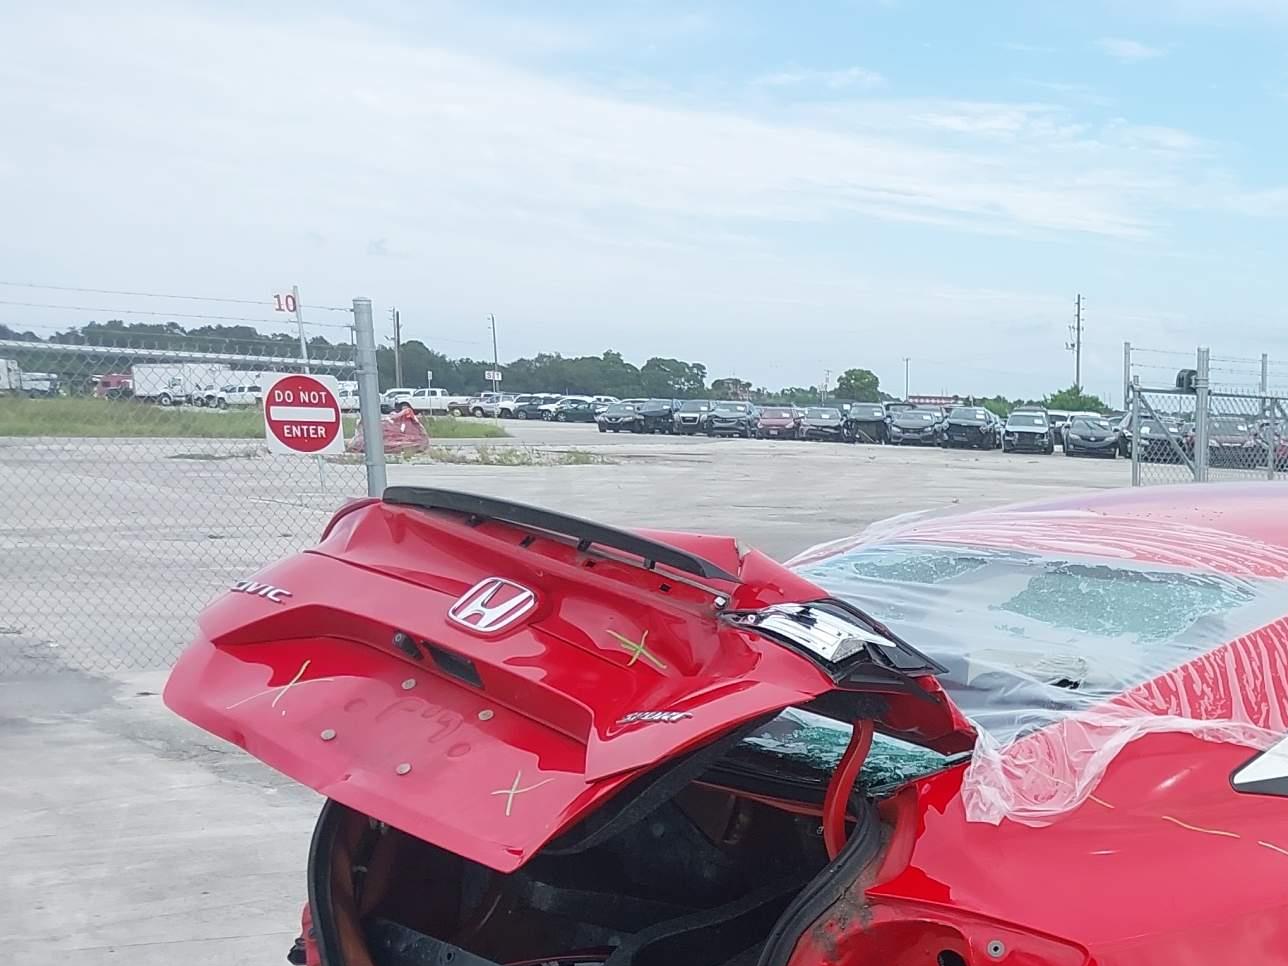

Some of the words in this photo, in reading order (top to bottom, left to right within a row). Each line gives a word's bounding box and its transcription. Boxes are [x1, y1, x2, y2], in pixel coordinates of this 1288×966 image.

[273, 294, 297, 313] 10
[274, 389, 294, 403] DO
[300, 391, 327, 404] NOT
[283, 424, 326, 439] ENTER
